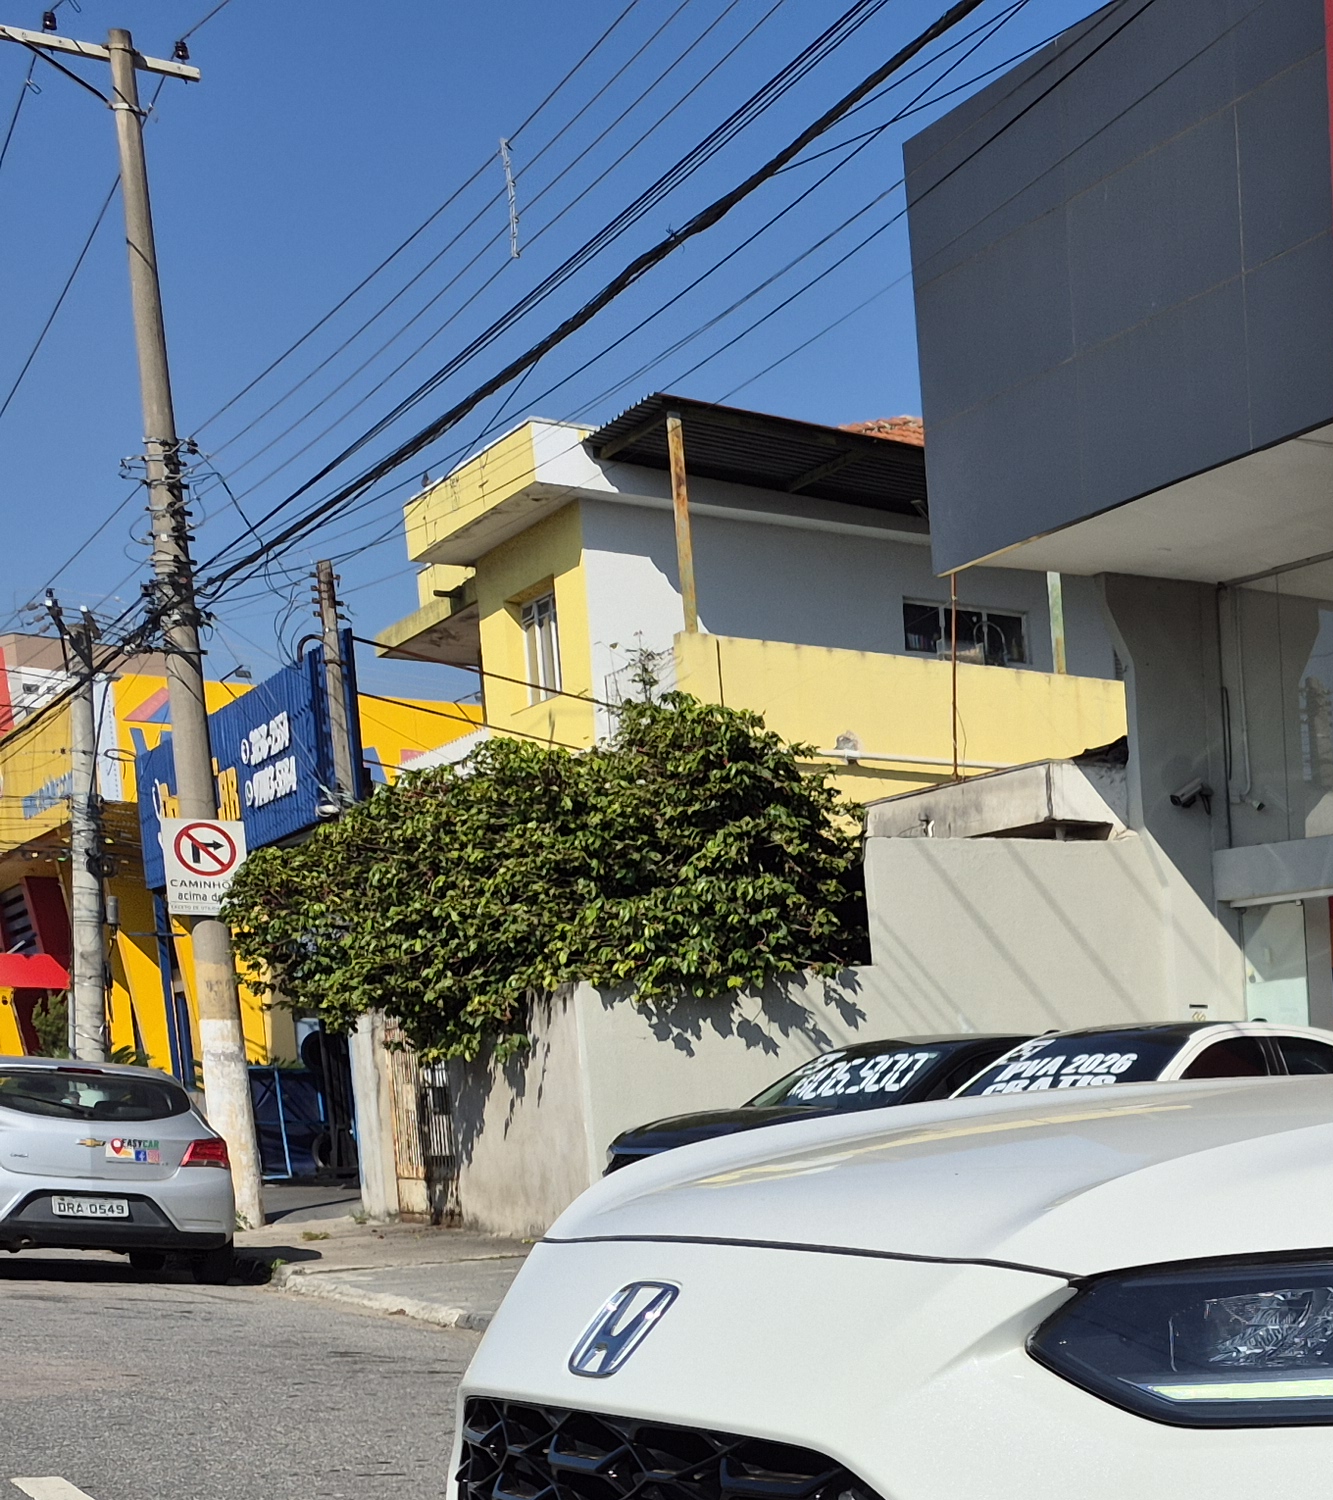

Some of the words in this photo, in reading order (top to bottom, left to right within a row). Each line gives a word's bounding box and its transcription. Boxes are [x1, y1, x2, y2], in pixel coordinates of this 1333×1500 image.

[177, 890, 208, 901] acima
[994, 1055, 1067, 1082] IPVA
[1060, 1053, 1138, 1075] 2026
[89, 1203, 124, 1214] 0549
